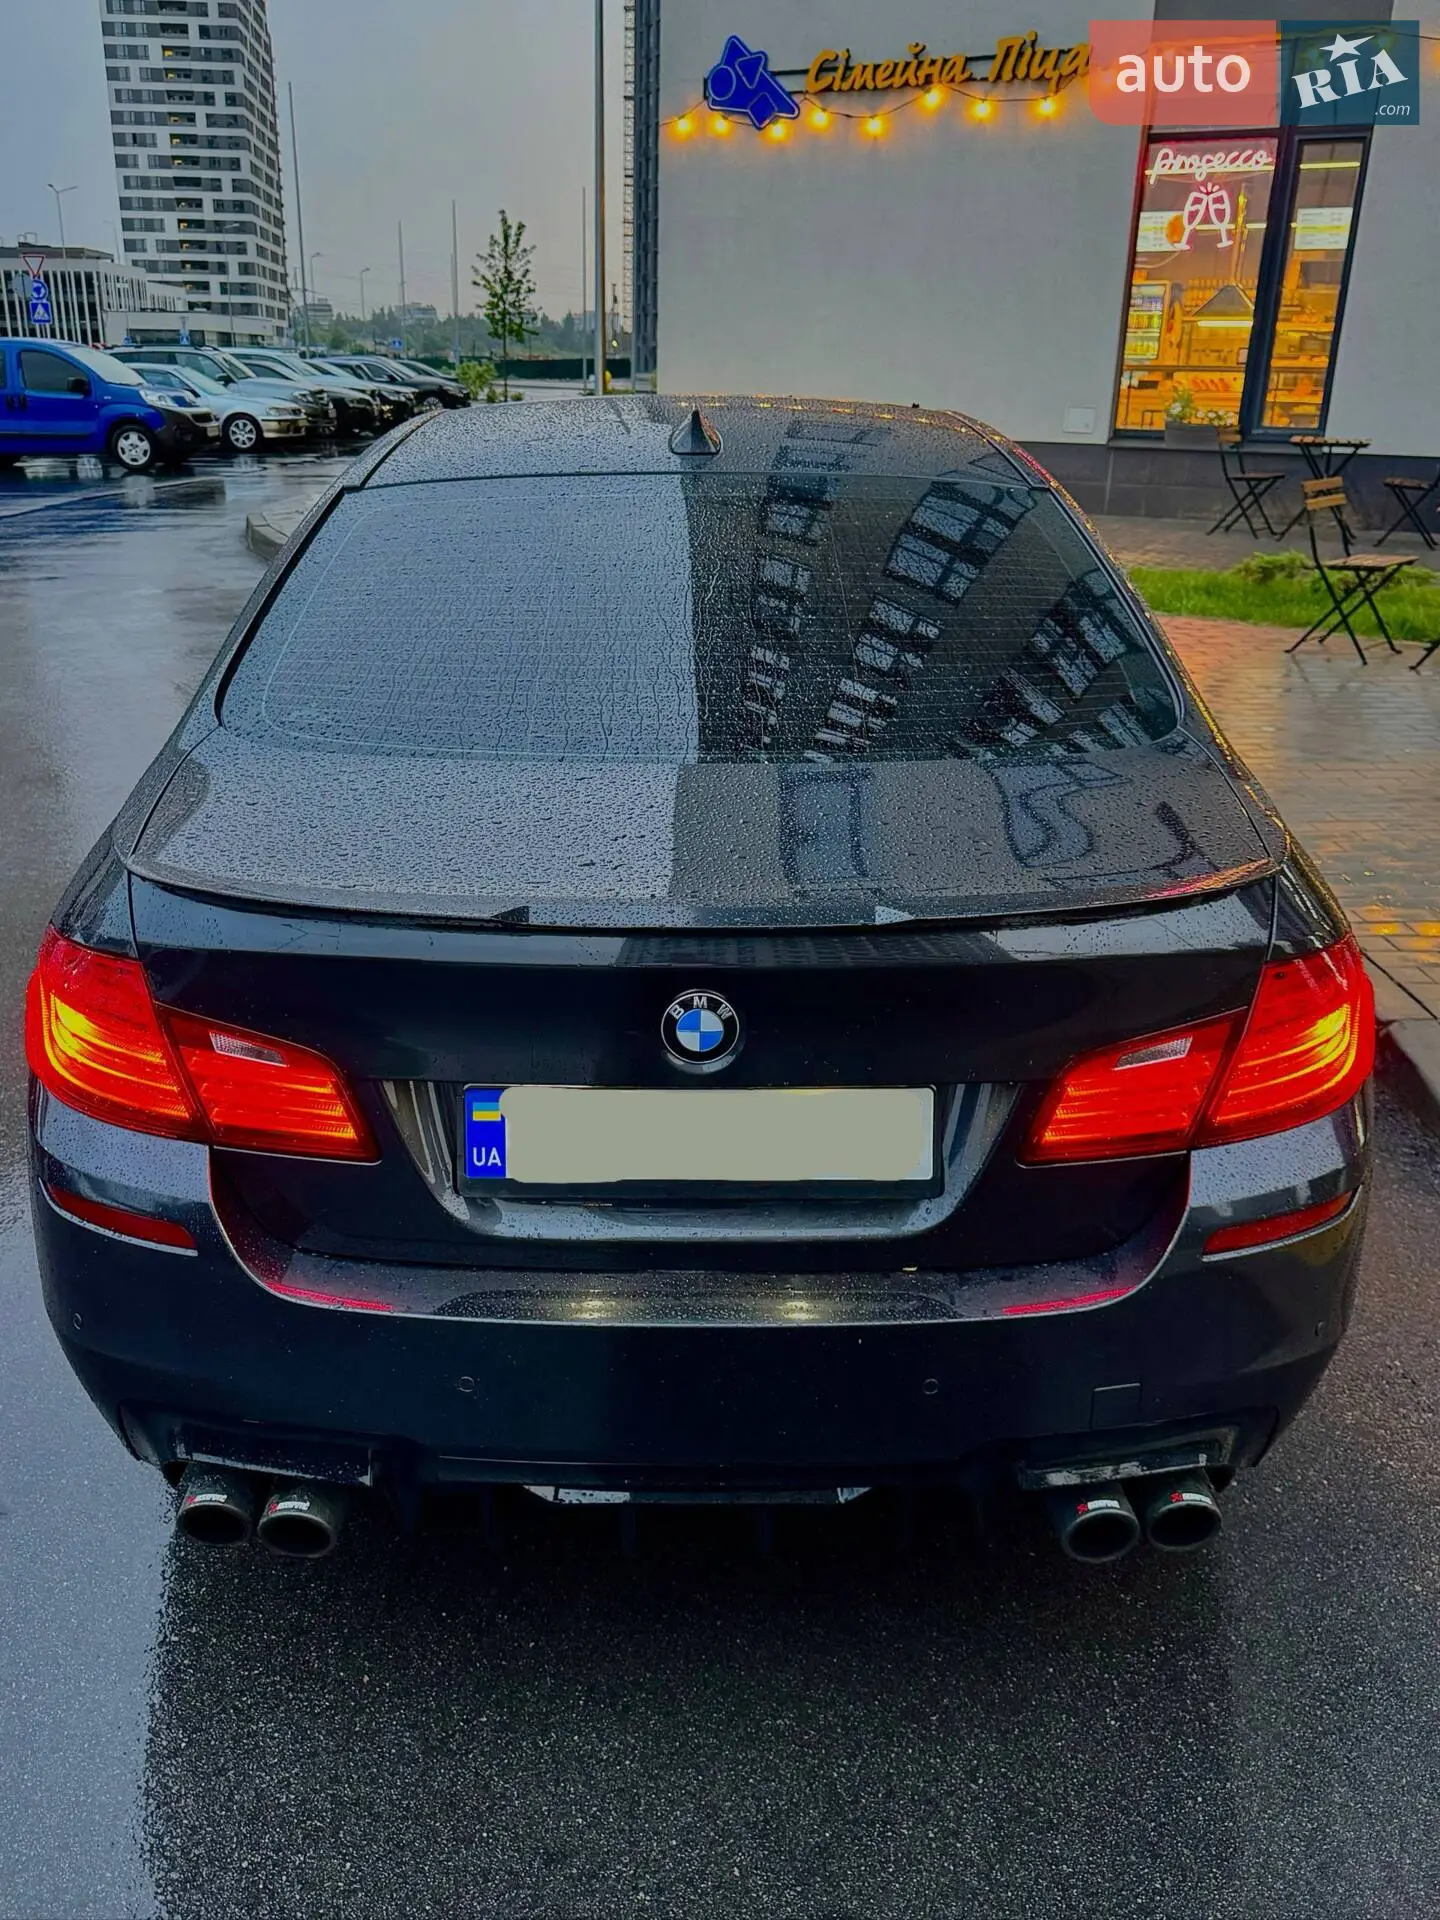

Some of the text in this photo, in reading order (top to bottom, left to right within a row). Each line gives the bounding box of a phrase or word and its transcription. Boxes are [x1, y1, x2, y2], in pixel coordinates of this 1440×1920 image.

[805, 30, 1091, 97] Сімейна Піца
[668, 995, 733, 1020] BMW
[472, 1146, 502, 1167] UA
